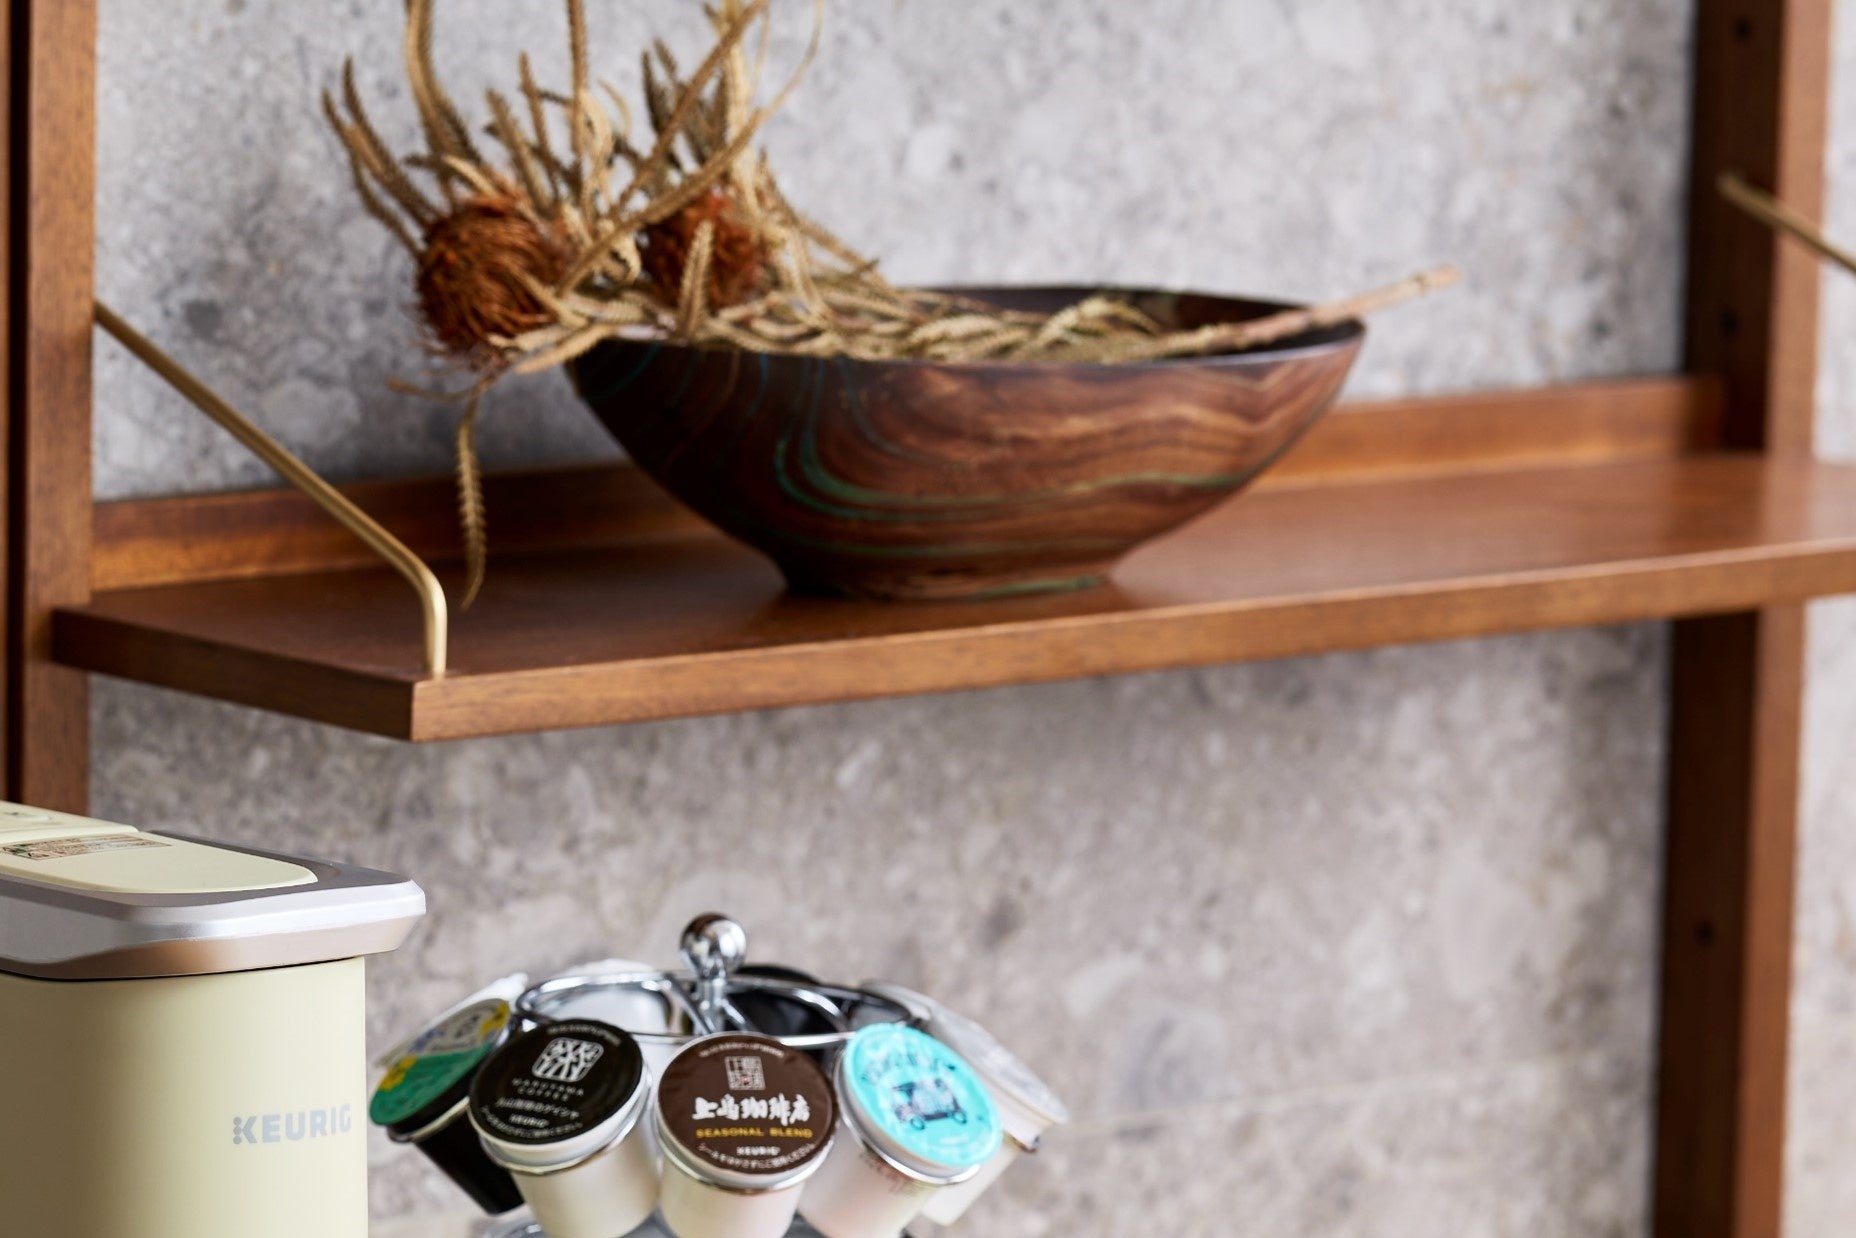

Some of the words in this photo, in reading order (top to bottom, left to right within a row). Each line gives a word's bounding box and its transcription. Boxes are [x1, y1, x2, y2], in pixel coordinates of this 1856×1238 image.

[232, 1103, 352, 1145] KEURIG
[696, 1128, 764, 1139] SEASONAL
[769, 1128, 814, 1139] BLEND
